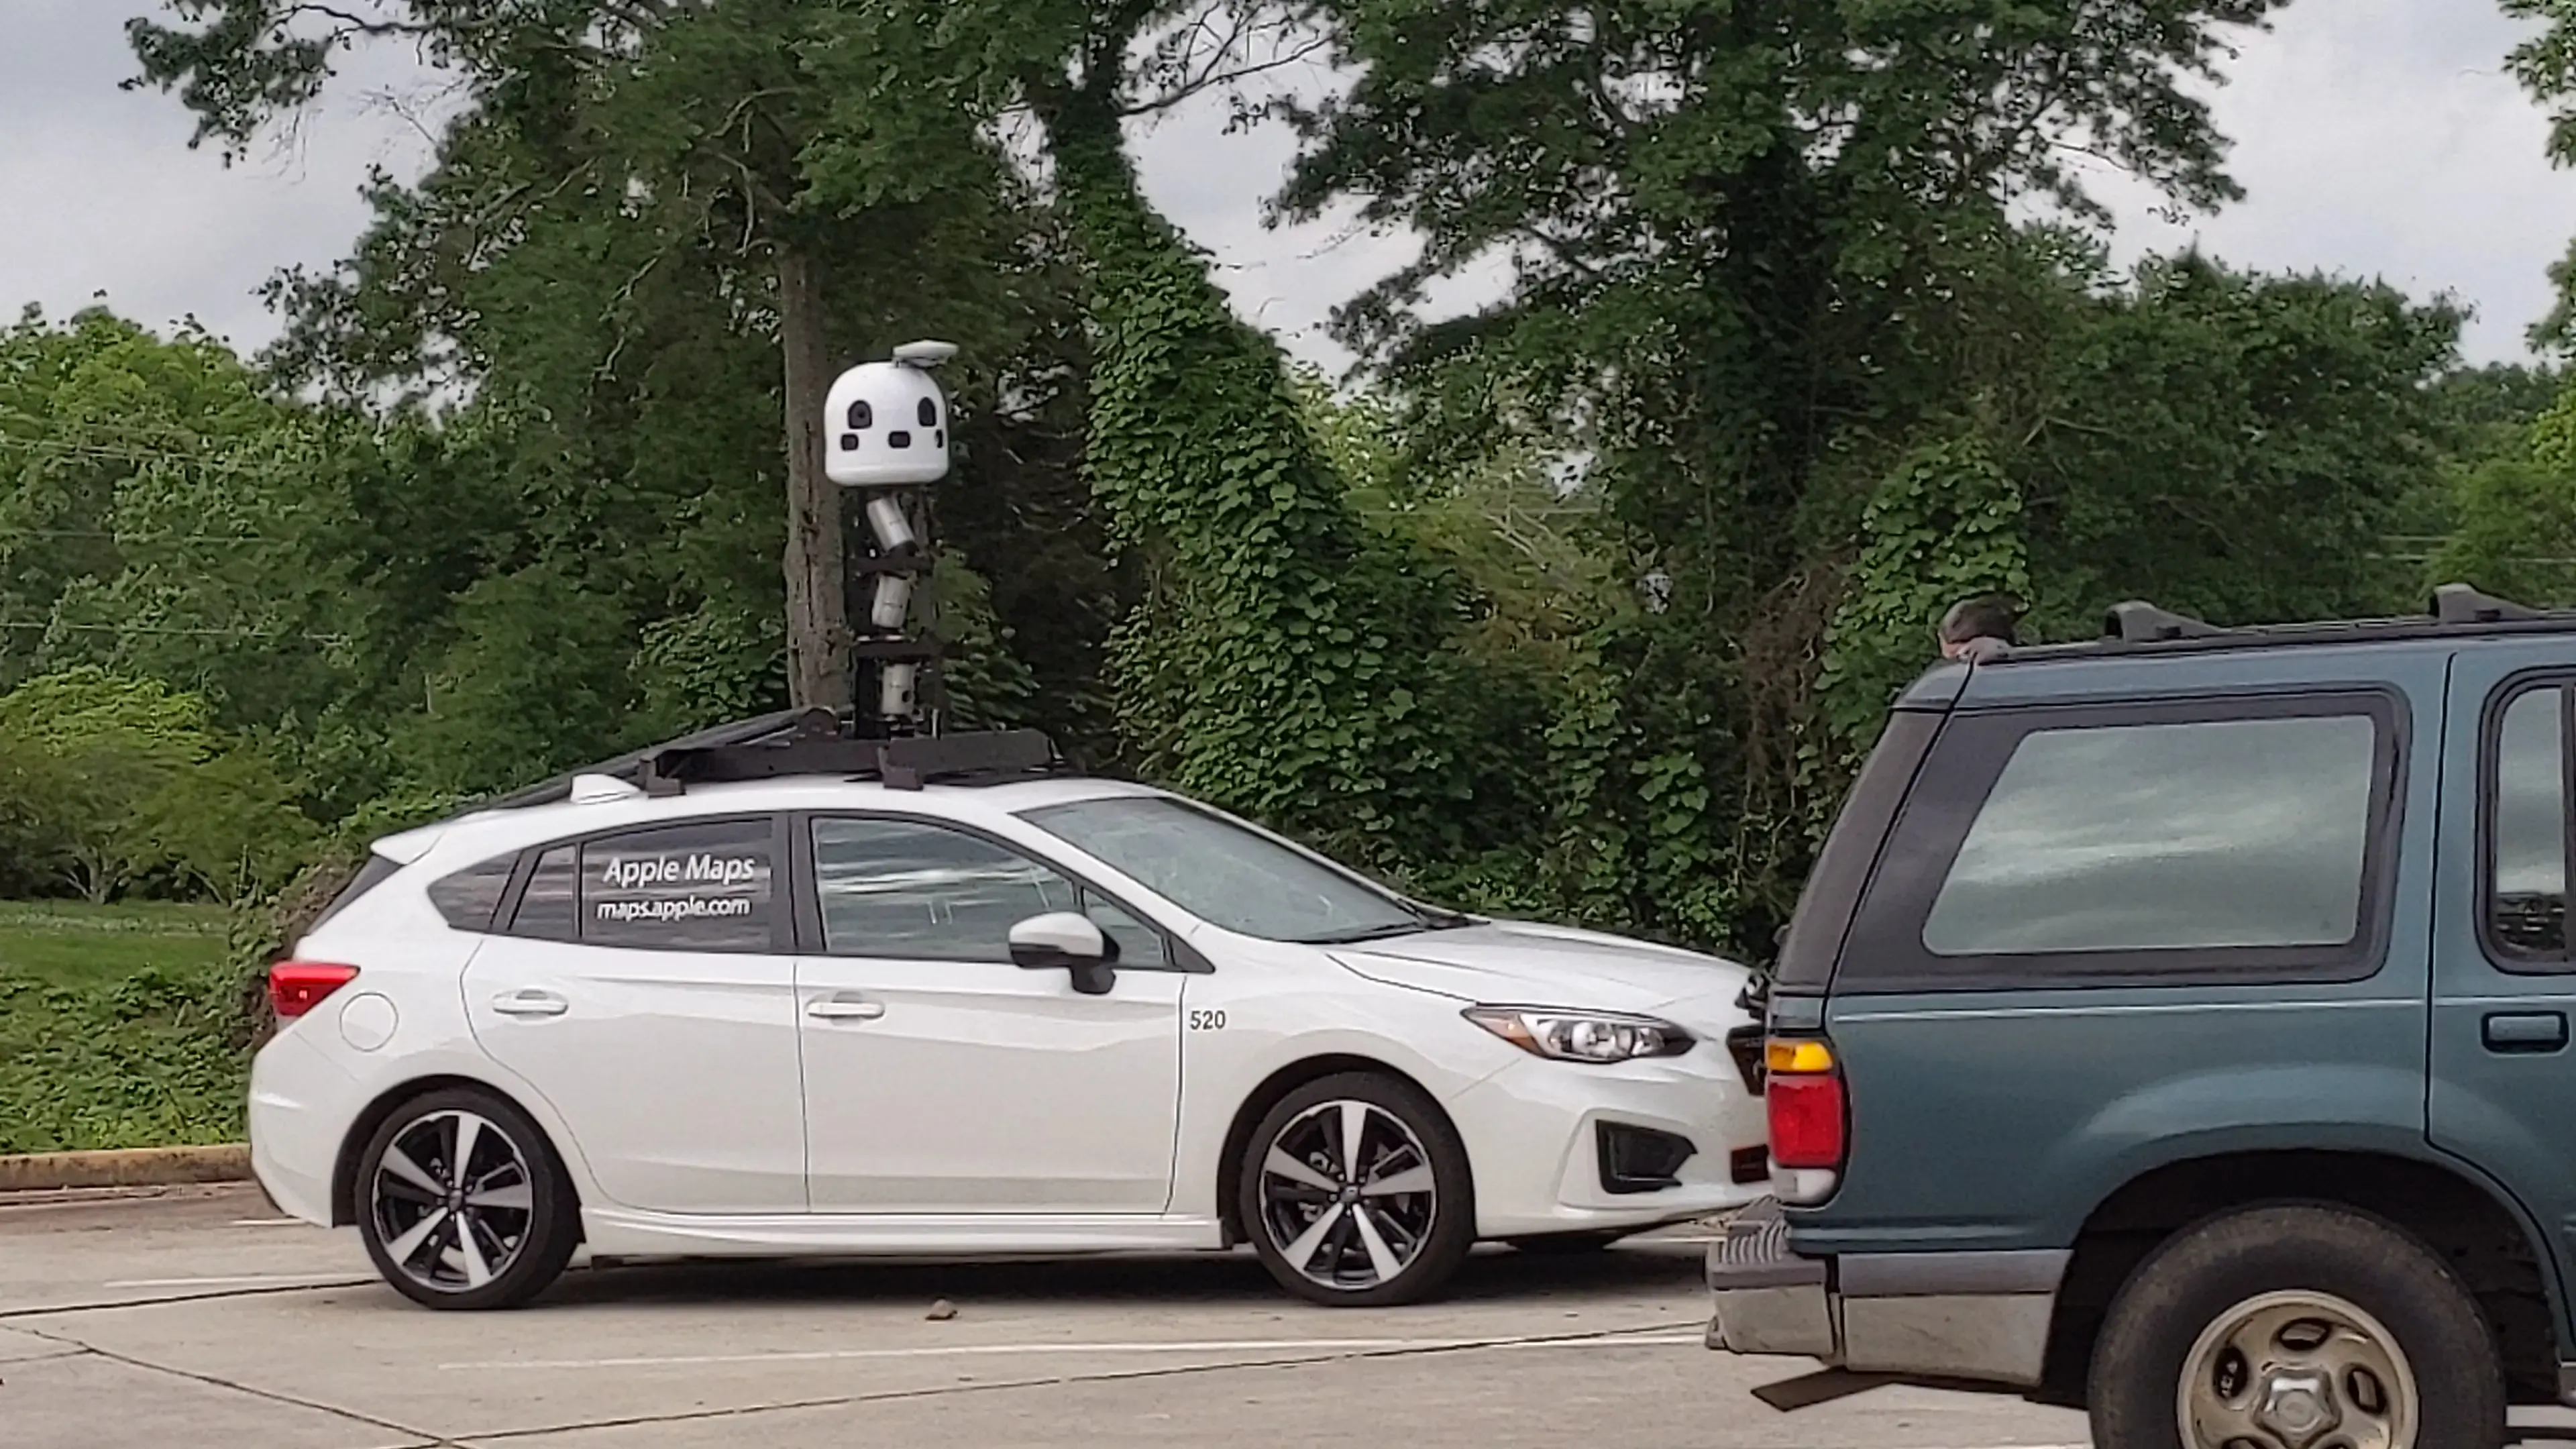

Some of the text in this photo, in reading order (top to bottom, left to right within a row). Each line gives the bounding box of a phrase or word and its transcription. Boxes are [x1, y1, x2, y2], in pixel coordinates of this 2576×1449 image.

[602, 854, 755, 889] Apple Maps
[596, 895, 750, 922] maps.apple.com
[1190, 1010, 1226, 1030] 520
